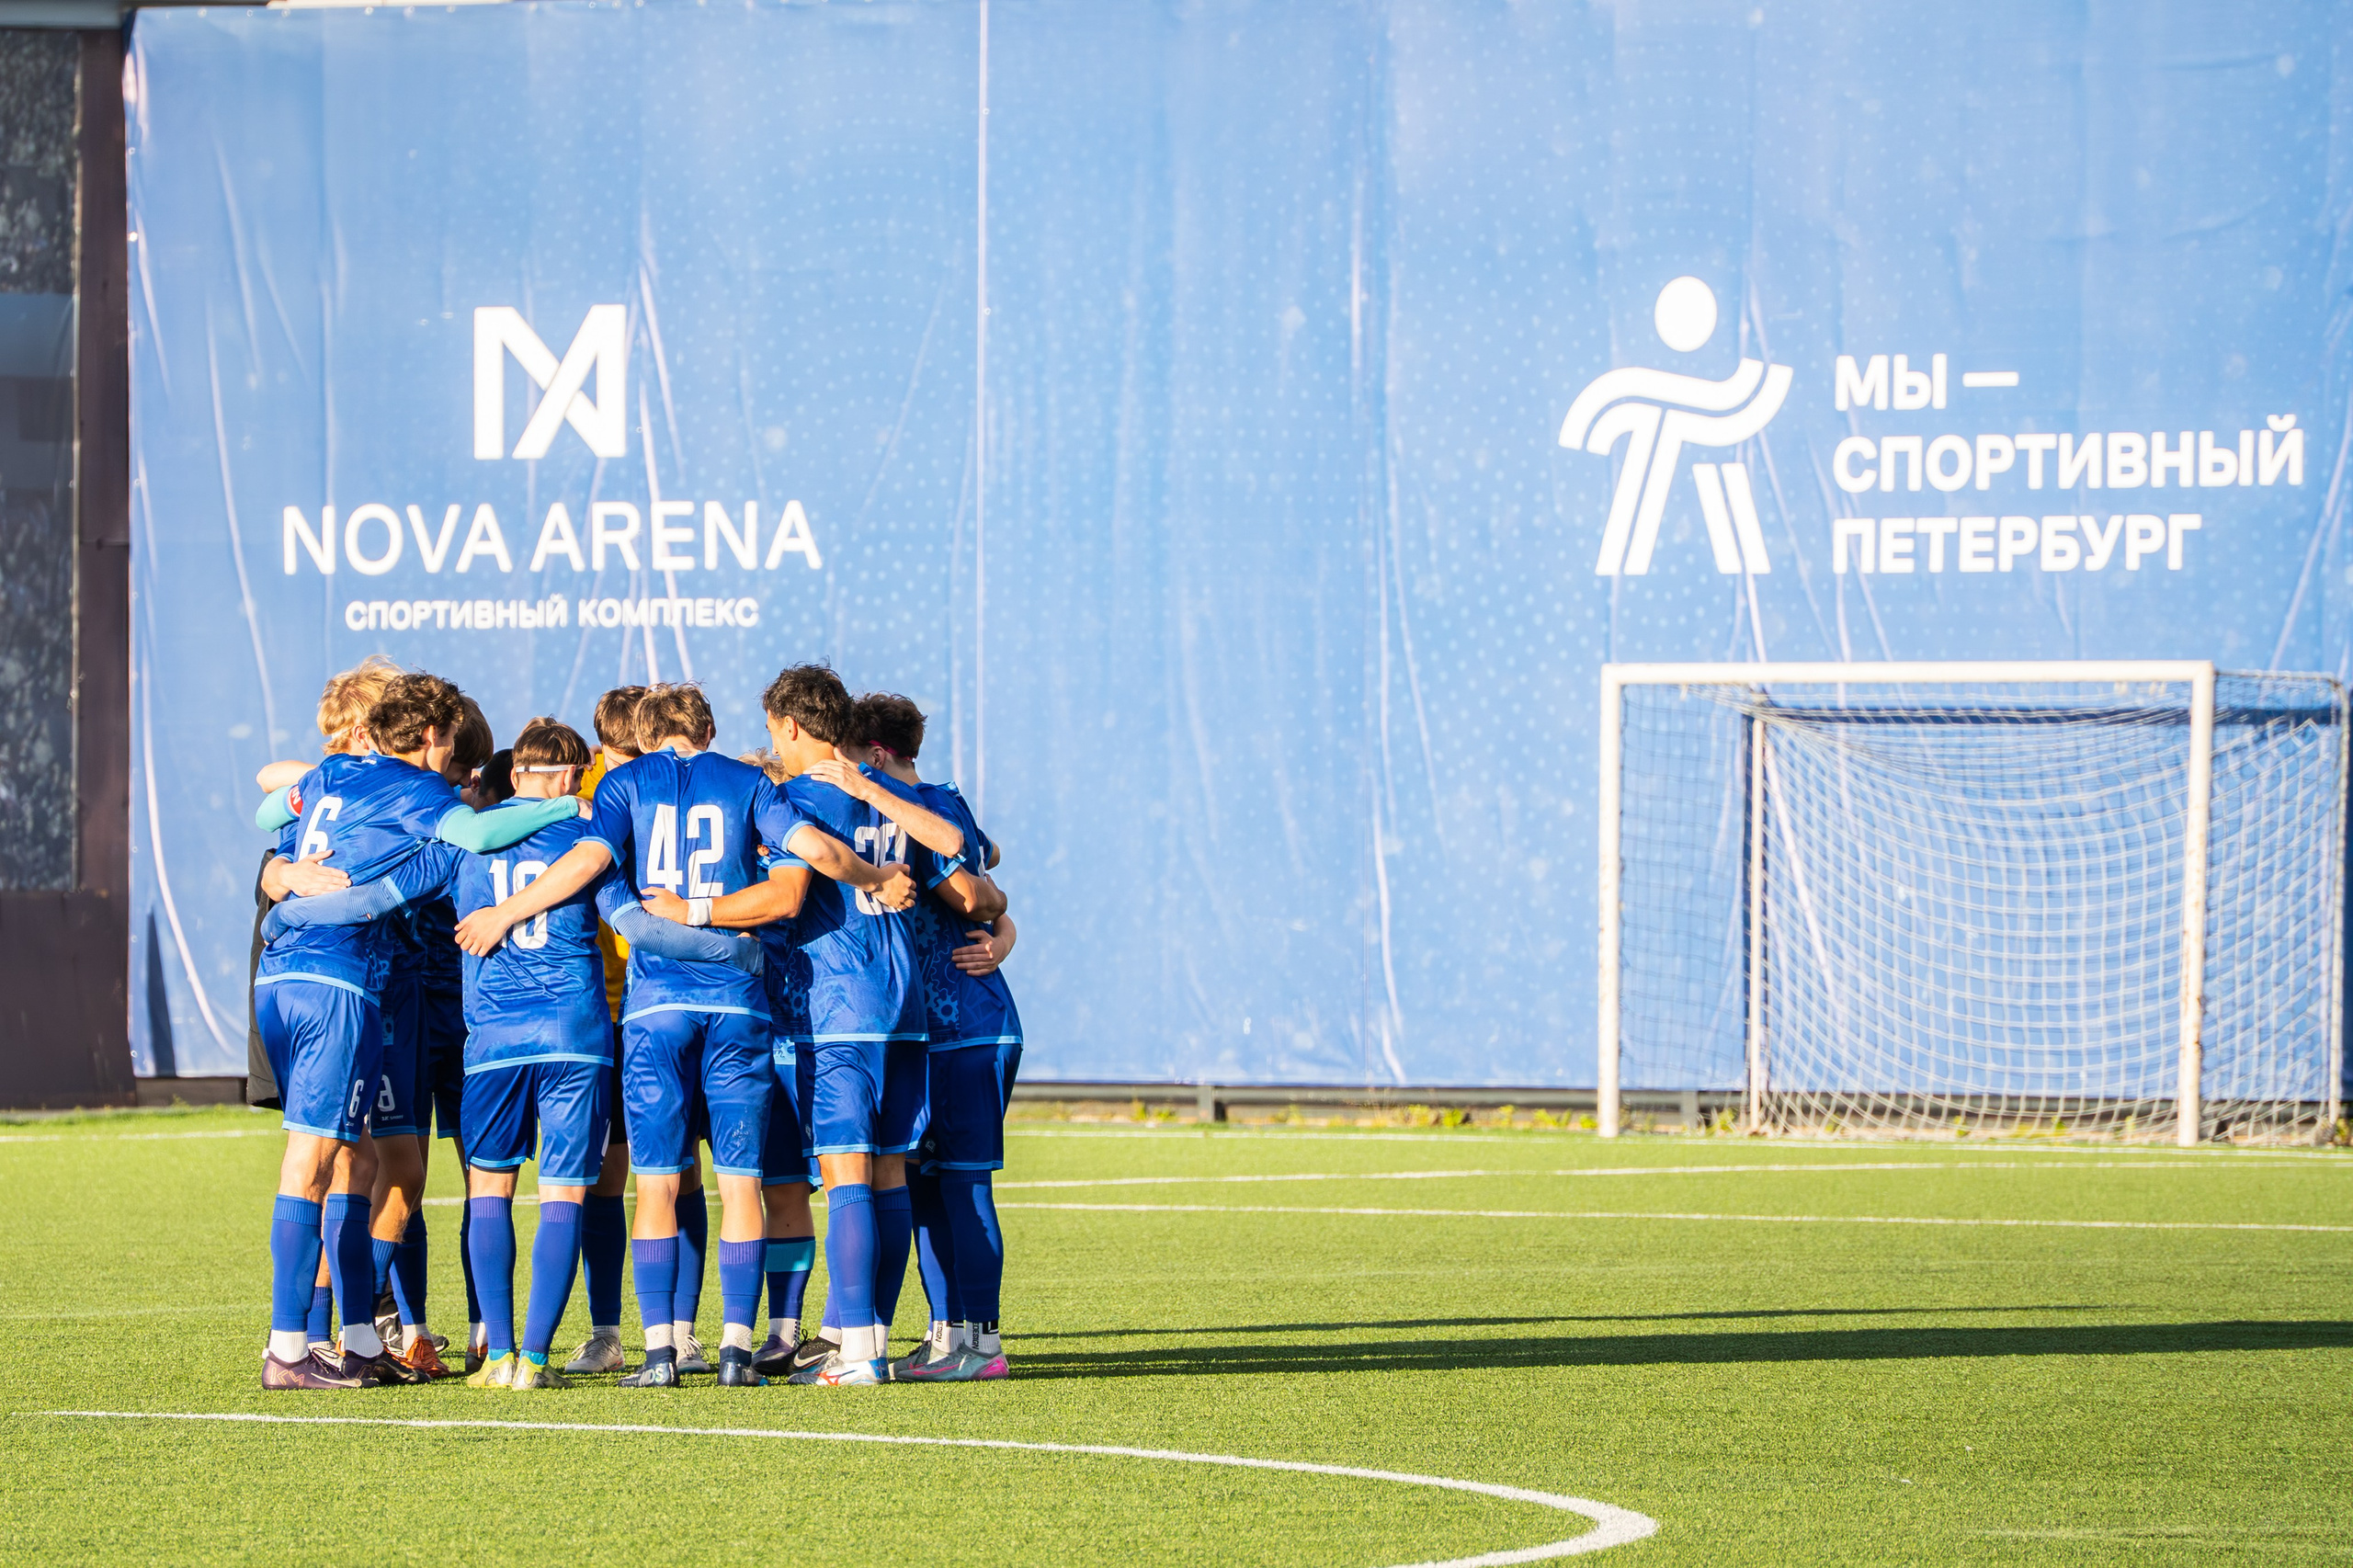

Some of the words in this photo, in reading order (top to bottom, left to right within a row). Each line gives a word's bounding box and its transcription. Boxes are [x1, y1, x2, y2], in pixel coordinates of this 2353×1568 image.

[1835, 354, 1948, 411] МЫ
[1833, 414, 2304, 493] СПОРТИВНЫЙ
[283, 504, 512, 575] NOVA
[529, 500, 823, 572] ARENA
[1833, 514, 2202, 574] ПЕТЕРБУРГ
[345, 594, 567, 631] СПОРТИВНЫЙ
[578, 597, 759, 628] КОМПЛЕКС
[646, 803, 724, 898] 42
[348, 1078, 365, 1119] 6
